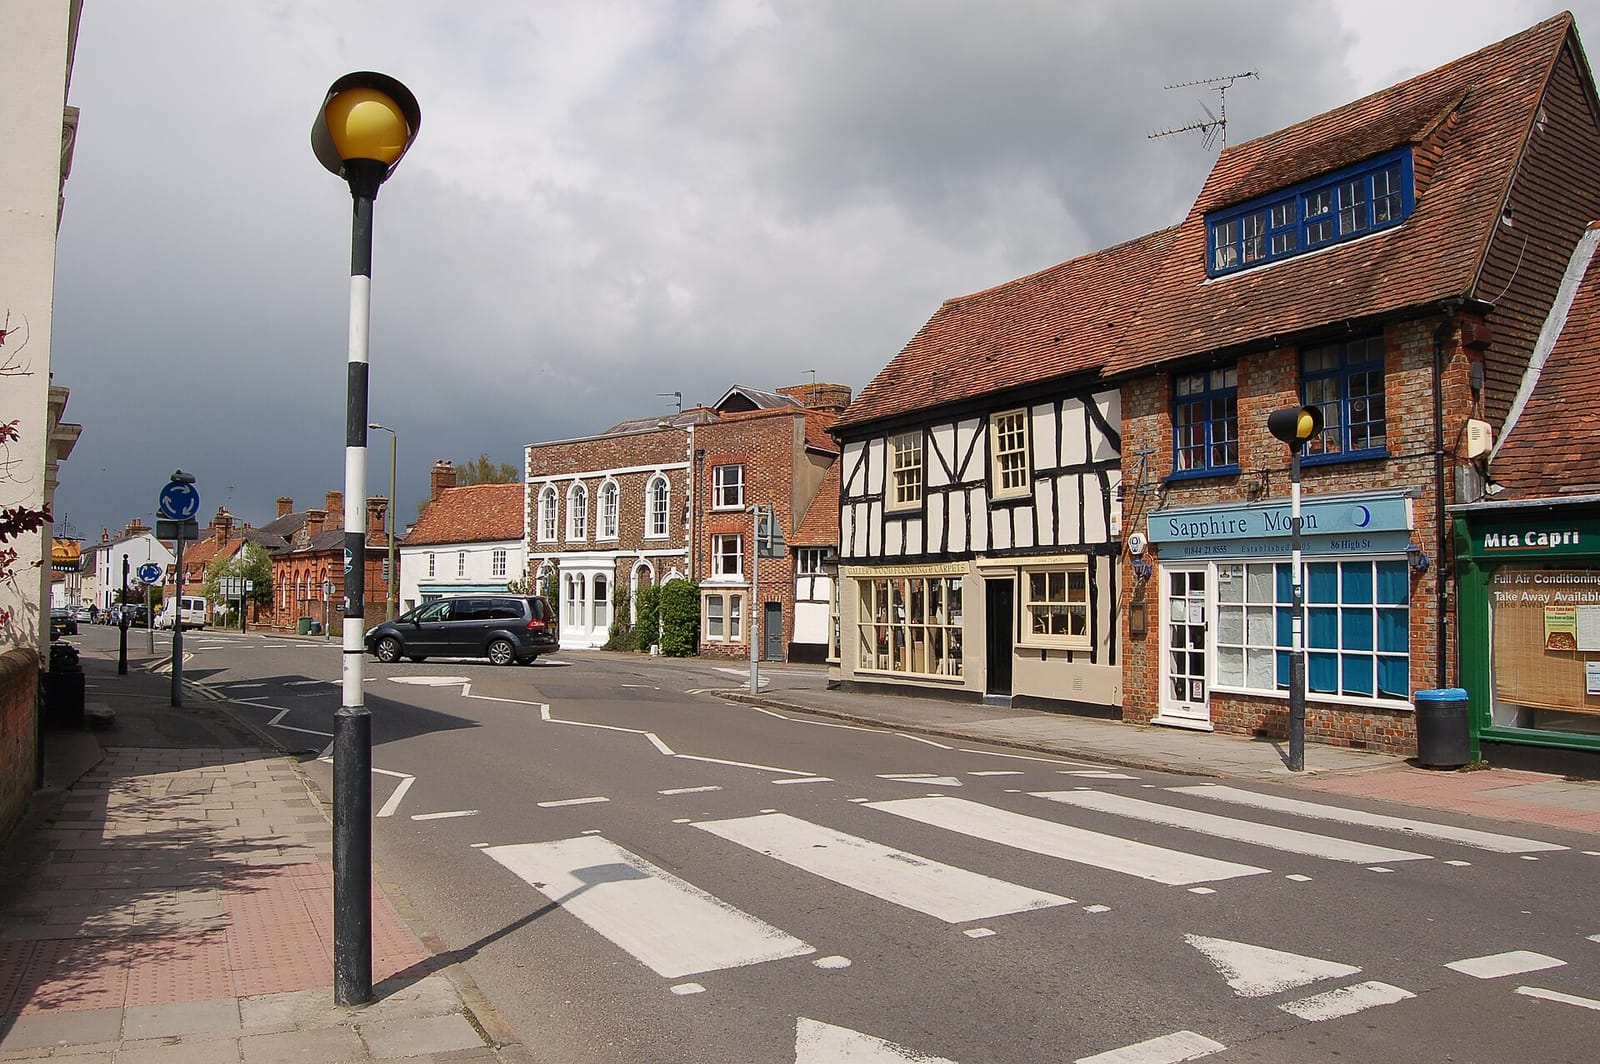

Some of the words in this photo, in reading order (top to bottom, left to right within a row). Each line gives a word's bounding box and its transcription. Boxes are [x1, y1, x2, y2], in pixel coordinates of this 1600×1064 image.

[1169, 514, 1247, 539] Sapphire
[1484, 529, 1519, 548] Mia
[1524, 528, 1579, 548] Capri
[1184, 545, 1202, 555] 01844
[1241, 543, 1290, 553] Established
[1341, 540, 1360, 550] High
[1494, 574, 1511, 584] Full
[1515, 573, 1530, 584] Air
[1493, 591, 1518, 602] Take
[1521, 591, 1550, 604] Away
[1554, 591, 1600, 602] Availabl
